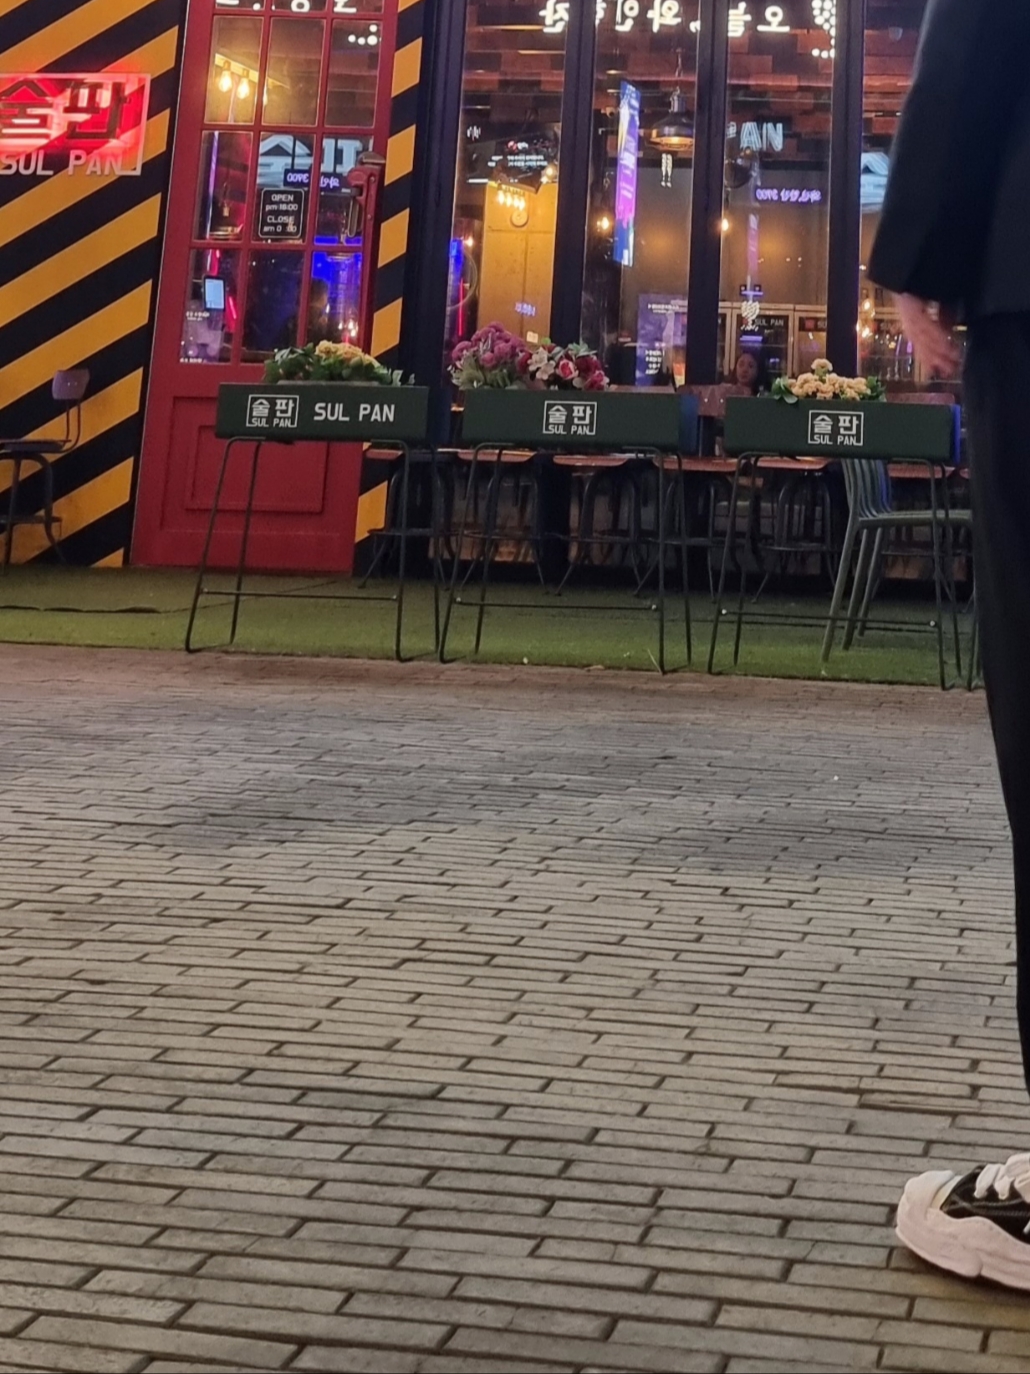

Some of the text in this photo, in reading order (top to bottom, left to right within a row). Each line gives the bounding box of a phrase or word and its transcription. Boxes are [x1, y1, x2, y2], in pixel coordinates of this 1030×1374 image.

[0, 78, 130, 139] 술판
[0, 149, 123, 176] SUL PAN
[271, 193, 294, 202] OPEN
[267, 215, 295, 224] CLOSE
[252, 398, 295, 418] 술판
[313, 402, 395, 423] SUL PAN
[548, 405, 592, 424] 술판
[251, 417, 292, 428] SUL PAN
[548, 424, 590, 435] SUL PAN
[813, 414, 859, 435] 술판
[813, 434, 857, 446] SUL PAN
